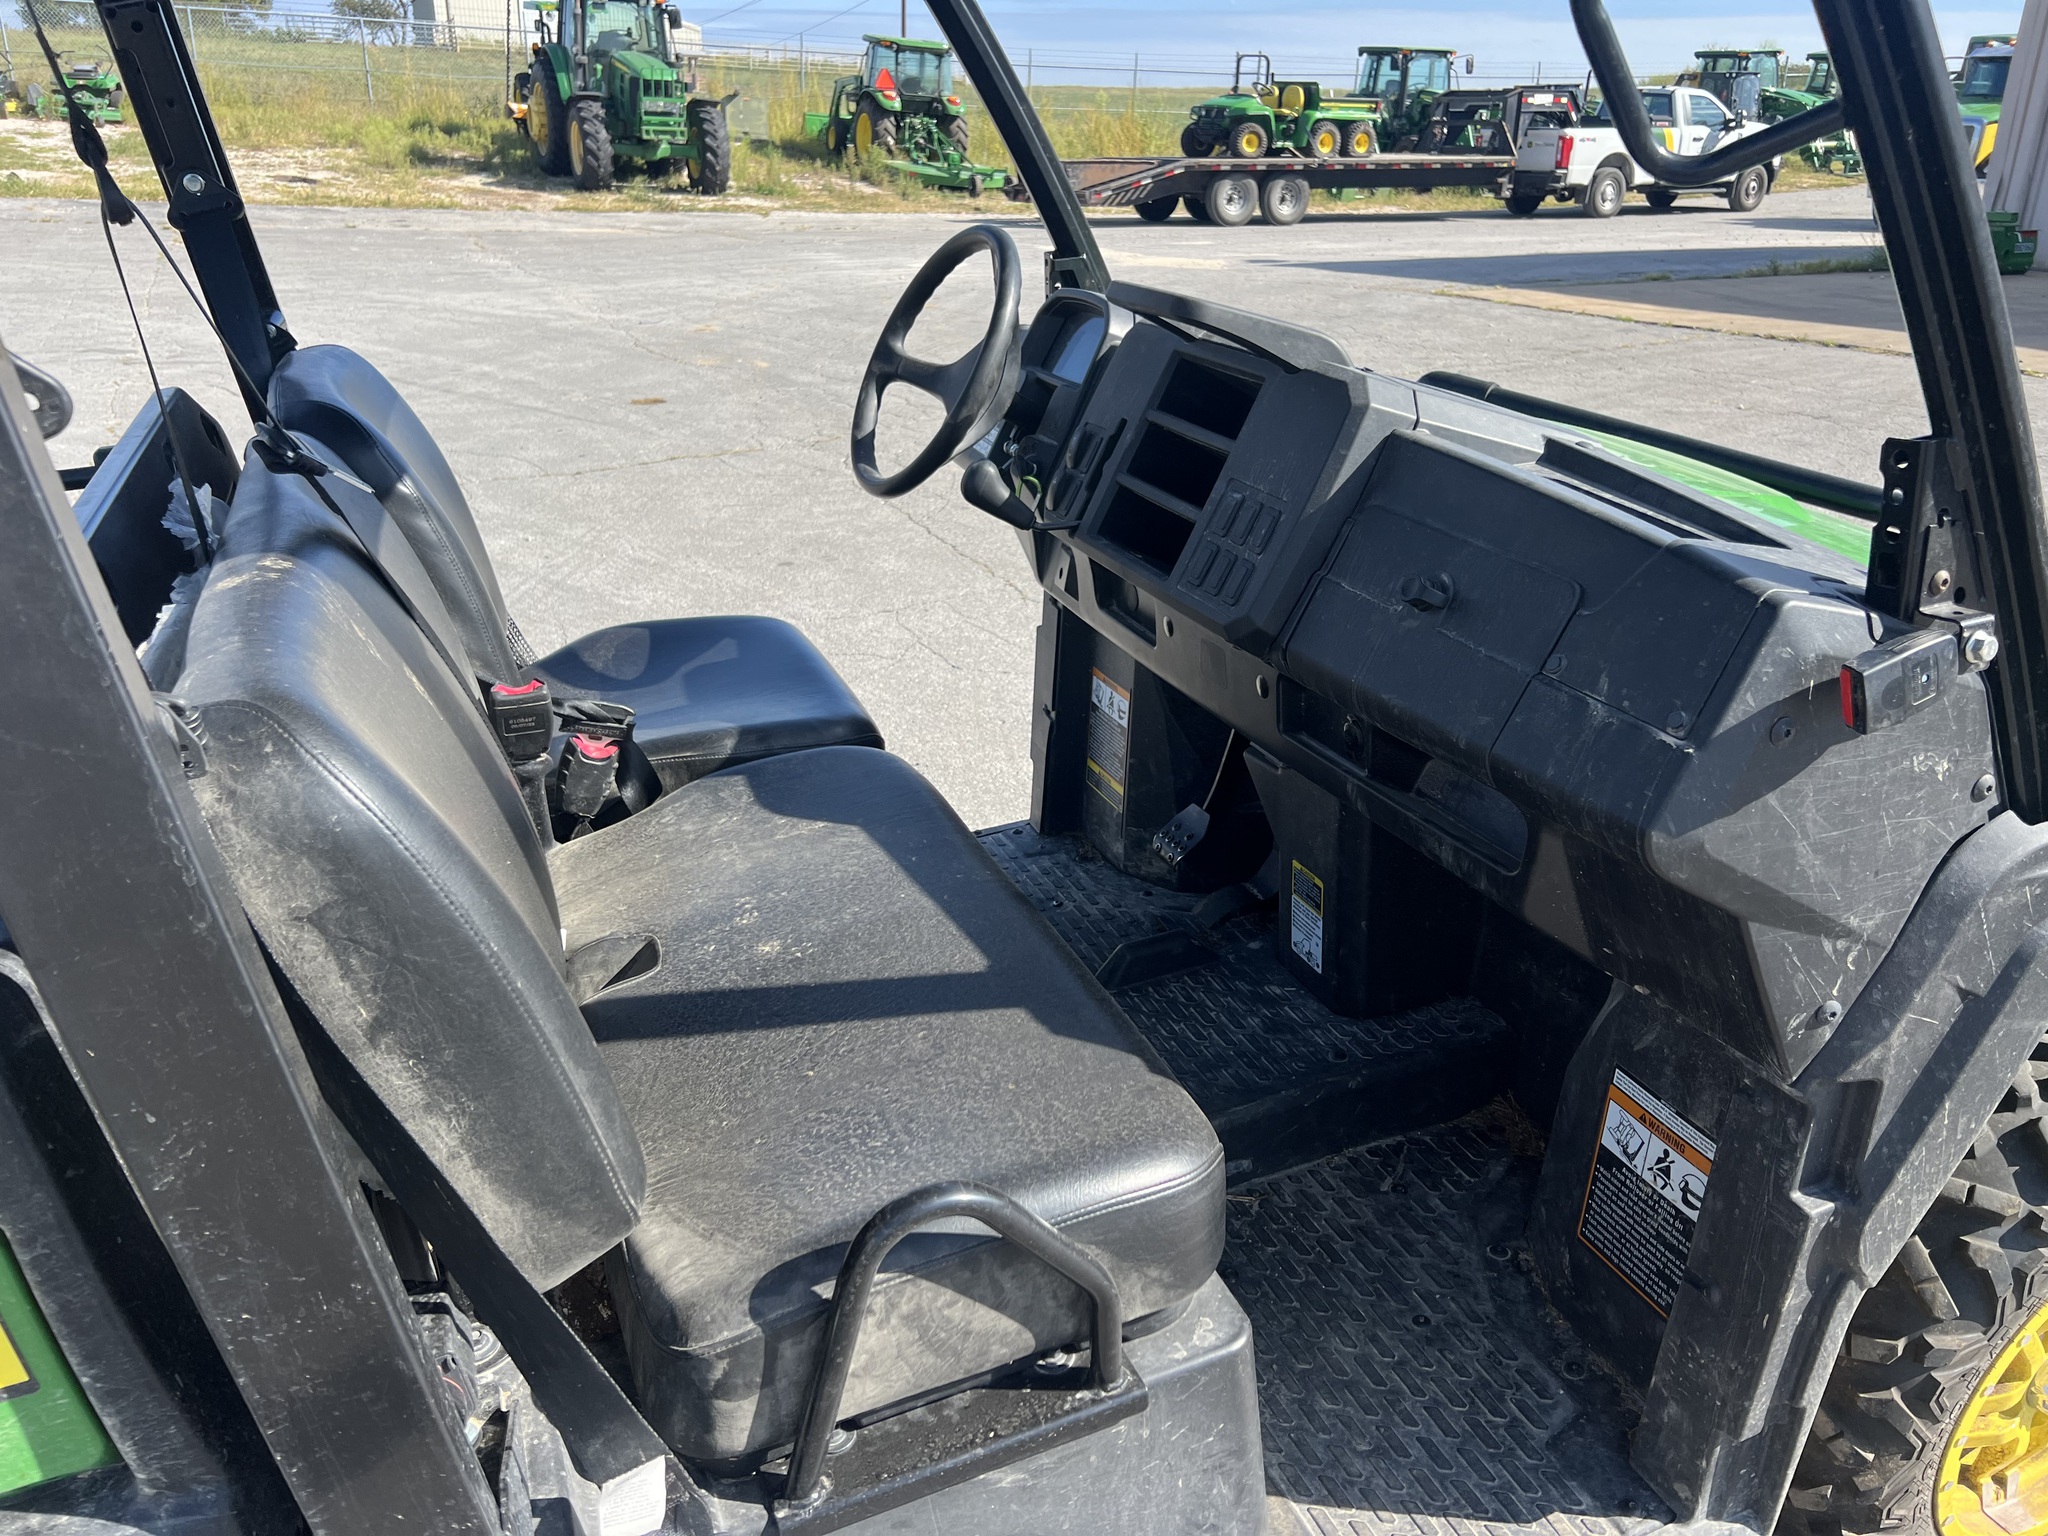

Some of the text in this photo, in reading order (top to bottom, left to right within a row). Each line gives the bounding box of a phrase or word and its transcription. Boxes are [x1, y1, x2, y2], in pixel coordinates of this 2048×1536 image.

[1647, 1117, 1686, 1154] WARNING
[1597, 1172, 1618, 1195] Passengers
[1646, 1215, 1657, 1229] grasp
[1657, 1225, 1678, 1246] handholds
[1599, 1165, 1610, 1179] Watch
[1657, 1215, 1672, 1232] manual
[1672, 1228, 1685, 1243] before
[1600, 1201, 1612, 1215] safety
[1611, 1211, 1631, 1232] equipment
[1612, 1166, 1625, 1182] From
[1625, 1178, 1647, 1201] Rollover
[1654, 1203, 1673, 1224] Falling
[1674, 1219, 1683, 1231] Off
[1621, 1166, 1636, 1182] Avoid
[1636, 1179, 1652, 1197] Injury
[1659, 1198, 1676, 1216] Death
[1591, 1201, 1600, 1213] Wear
[1601, 1210, 1615, 1226] helmets
[1615, 1223, 1625, 1235] when
[1625, 1232, 1638, 1248] driving
[1594, 1187, 1607, 1201] Vehicle
[1610, 1201, 1626, 1219] equipped
[1633, 1221, 1649, 1239] seatbelts
[1664, 1249, 1675, 1262] doors
[1594, 1213, 1607, 1227] uneven
[1629, 1245, 1642, 1260] higher
[1596, 1223, 1612, 1242] occupant
[1631, 1254, 1650, 1274] individual
[1585, 1229, 1594, 1242] Keep
[1594, 1238, 1603, 1250] arms
[1618, 1260, 1630, 1274] inside
[1630, 1271, 1644, 1288] vehicle
[1644, 1284, 1657, 1300] during
[1586, 1223, 1604, 1243] occupants
[1603, 1238, 1613, 1250] must
[1619, 1252, 1633, 1268] exceed
[1633, 1265, 1647, 1281] number
